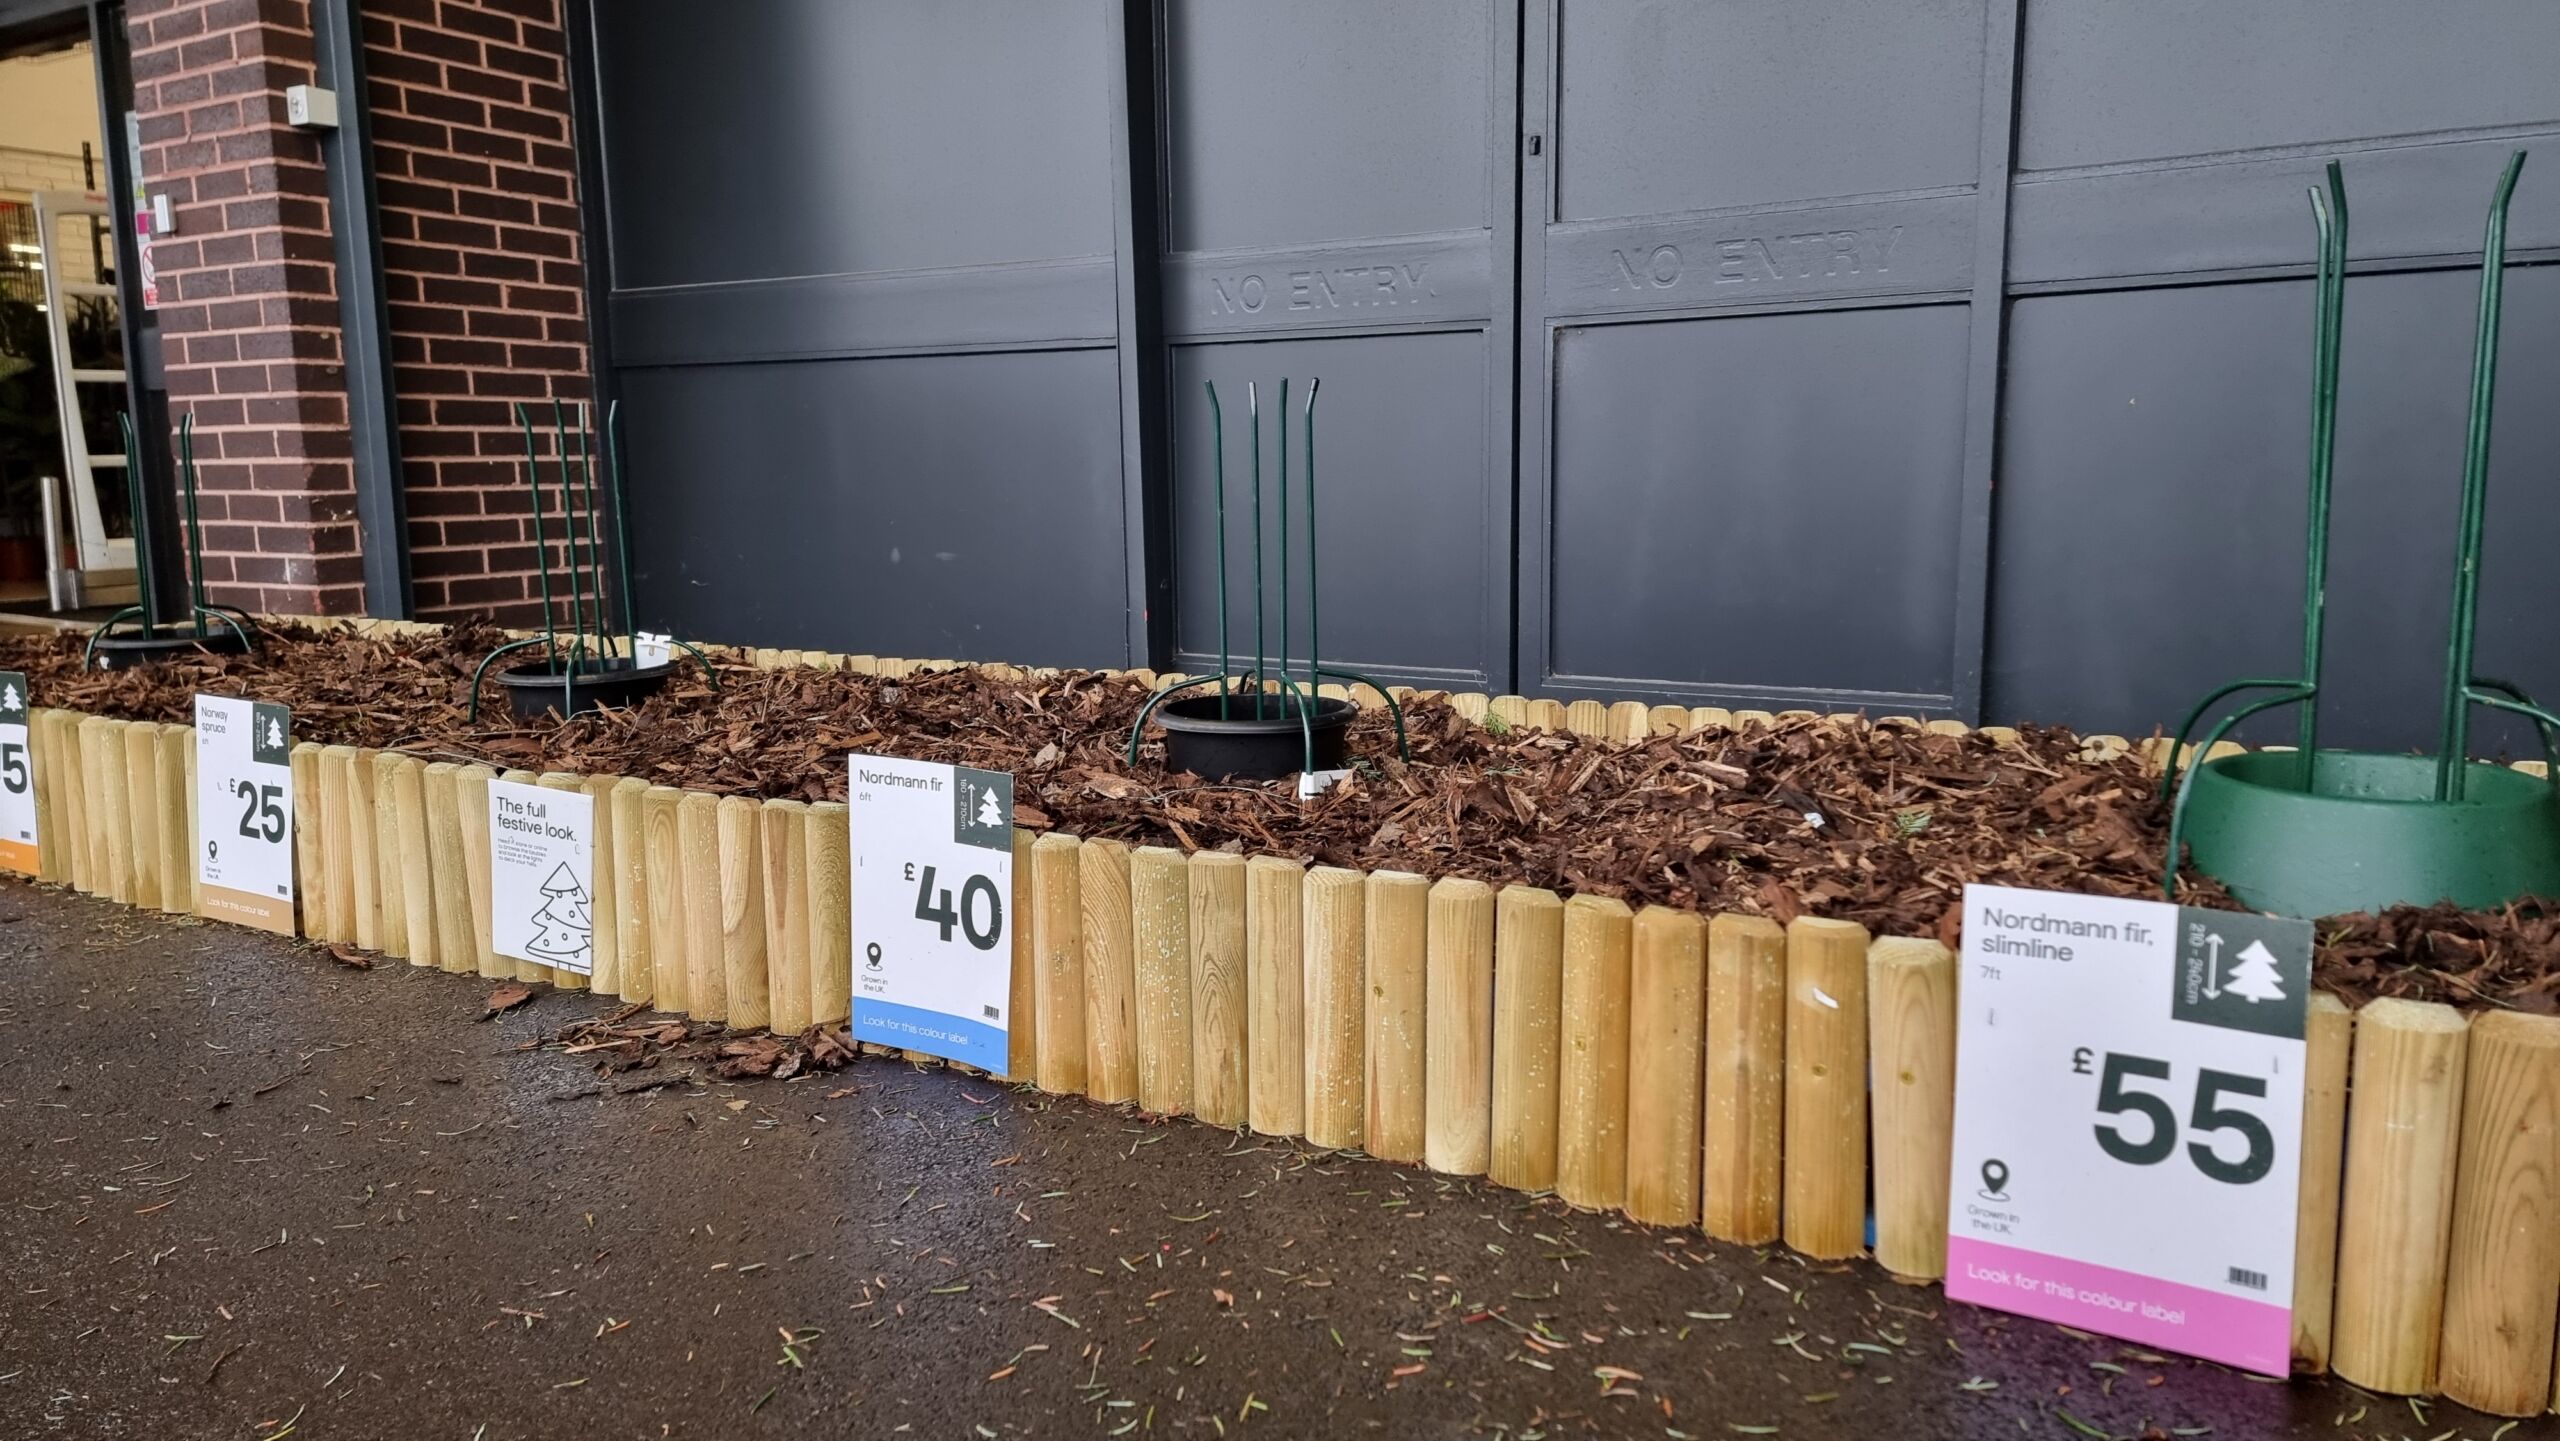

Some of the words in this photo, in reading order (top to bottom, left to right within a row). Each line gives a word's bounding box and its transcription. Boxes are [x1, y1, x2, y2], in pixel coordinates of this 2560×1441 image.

[1610, 244, 1684, 292] NO
[1715, 226, 1903, 284] ENTRY
[1211, 274, 1268, 315] NO
[1288, 263, 1430, 310] ENTRY
[201, 706, 228, 722] Norway
[201, 722, 226, 733] spruce
[0, 742, 28, 794] 5
[859, 769, 928, 790] Nordmann
[930, 777, 943, 791] fir
[230, 778, 286, 843] £25
[496, 796, 523, 814] The
[527, 802, 546, 818] full
[859, 792, 871, 801] 6ft
[497, 813, 542, 835] festive
[545, 822, 577, 842] look.
[904, 862, 1003, 951] £40
[1982, 906, 2117, 941] Nordmann
[2188, 922, 2206, 948] 210
[1981, 935, 2074, 962] slimline
[1980, 964, 2001, 981] 7ft
[863, 1014, 886, 1028] Look
[887, 1018, 900, 1030] for
[902, 1022, 917, 1034] this
[918, 1026, 946, 1040] colour
[948, 1031, 968, 1045] label
[2072, 1047, 2275, 1185] £55
[1966, 1204, 2007, 1222] Grown
[2009, 1212, 2020, 1224] in
[1972, 1218, 1991, 1231] the
[1967, 1263, 2010, 1285] Look
[2014, 1271, 2040, 1291] for
[2044, 1280, 2075, 1300] this
[2078, 1289, 2138, 1314] colour
[2141, 1302, 2186, 1326] label
